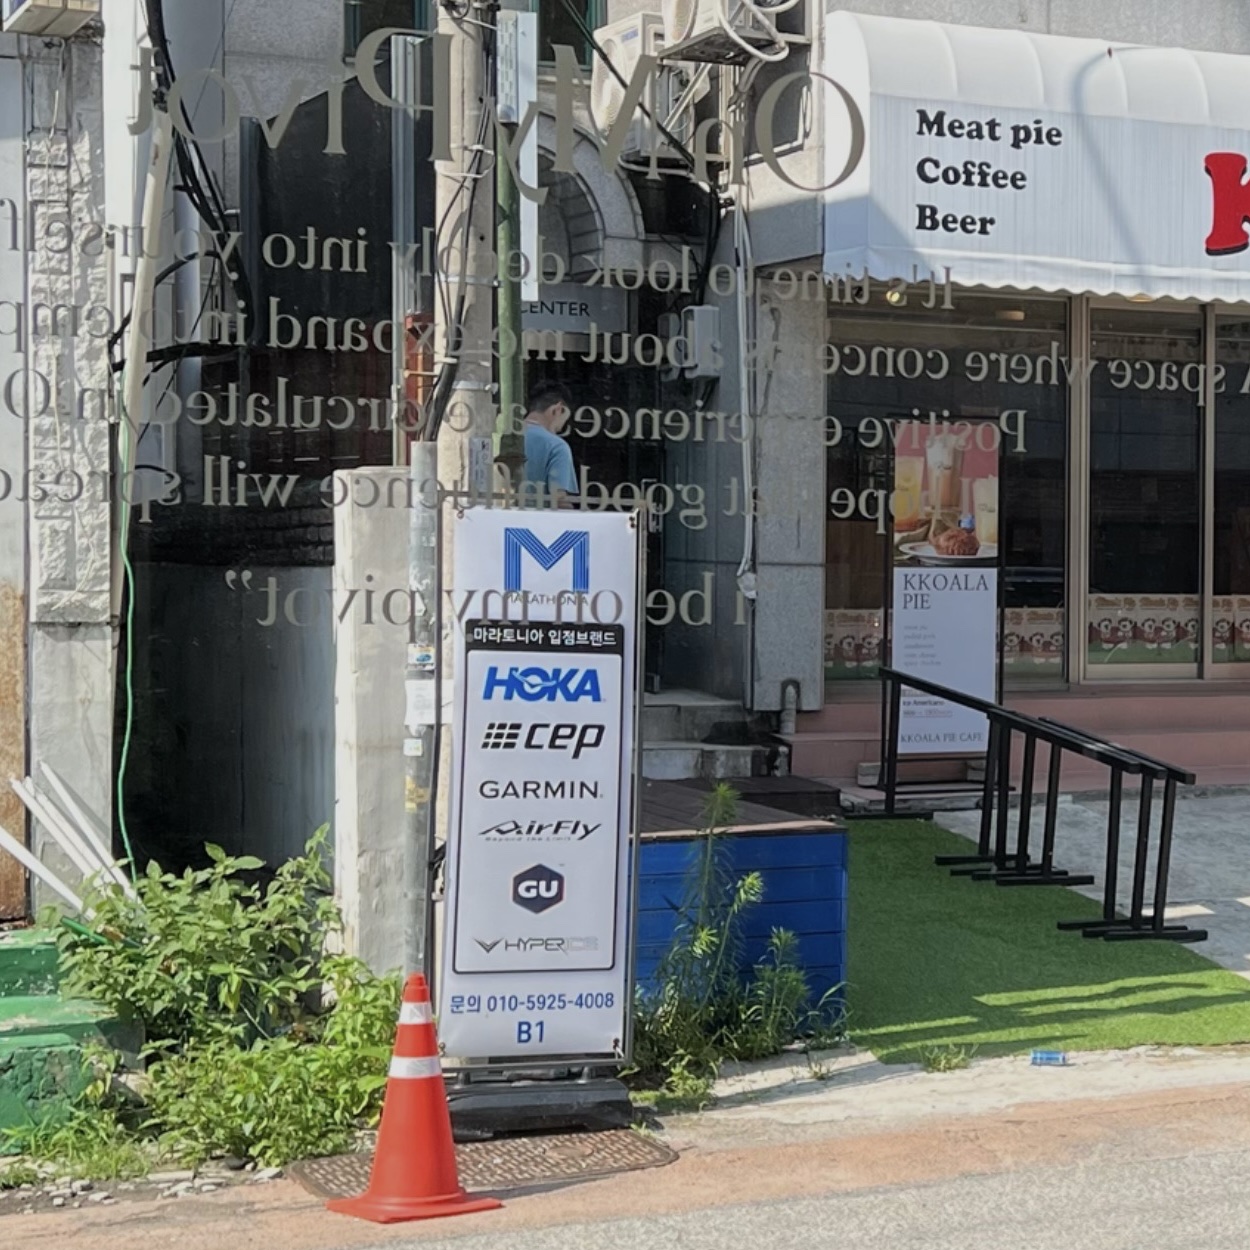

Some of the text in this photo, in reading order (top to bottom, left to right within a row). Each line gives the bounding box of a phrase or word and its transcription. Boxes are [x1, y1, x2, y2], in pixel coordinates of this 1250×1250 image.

[916, 109, 1063, 151] Meat pie
[915, 157, 1028, 191] Coffee
[915, 203, 997, 237] Beer
[520, 301, 591, 317] ENTER
[903, 573, 989, 592] KKOALA
[902, 592, 932, 610] PIE
[473, 627, 617, 647] 마라토니아 입점브랜드
[482, 666, 602, 702] HOKA
[524, 722, 606, 760] cep
[479, 780, 600, 799] GARMIN
[478, 820, 602, 841] AirFly
[517, 880, 559, 898] GU
[450, 992, 614, 1014] 문의 010-5925-4008
[516, 1020, 544, 1044] B1
